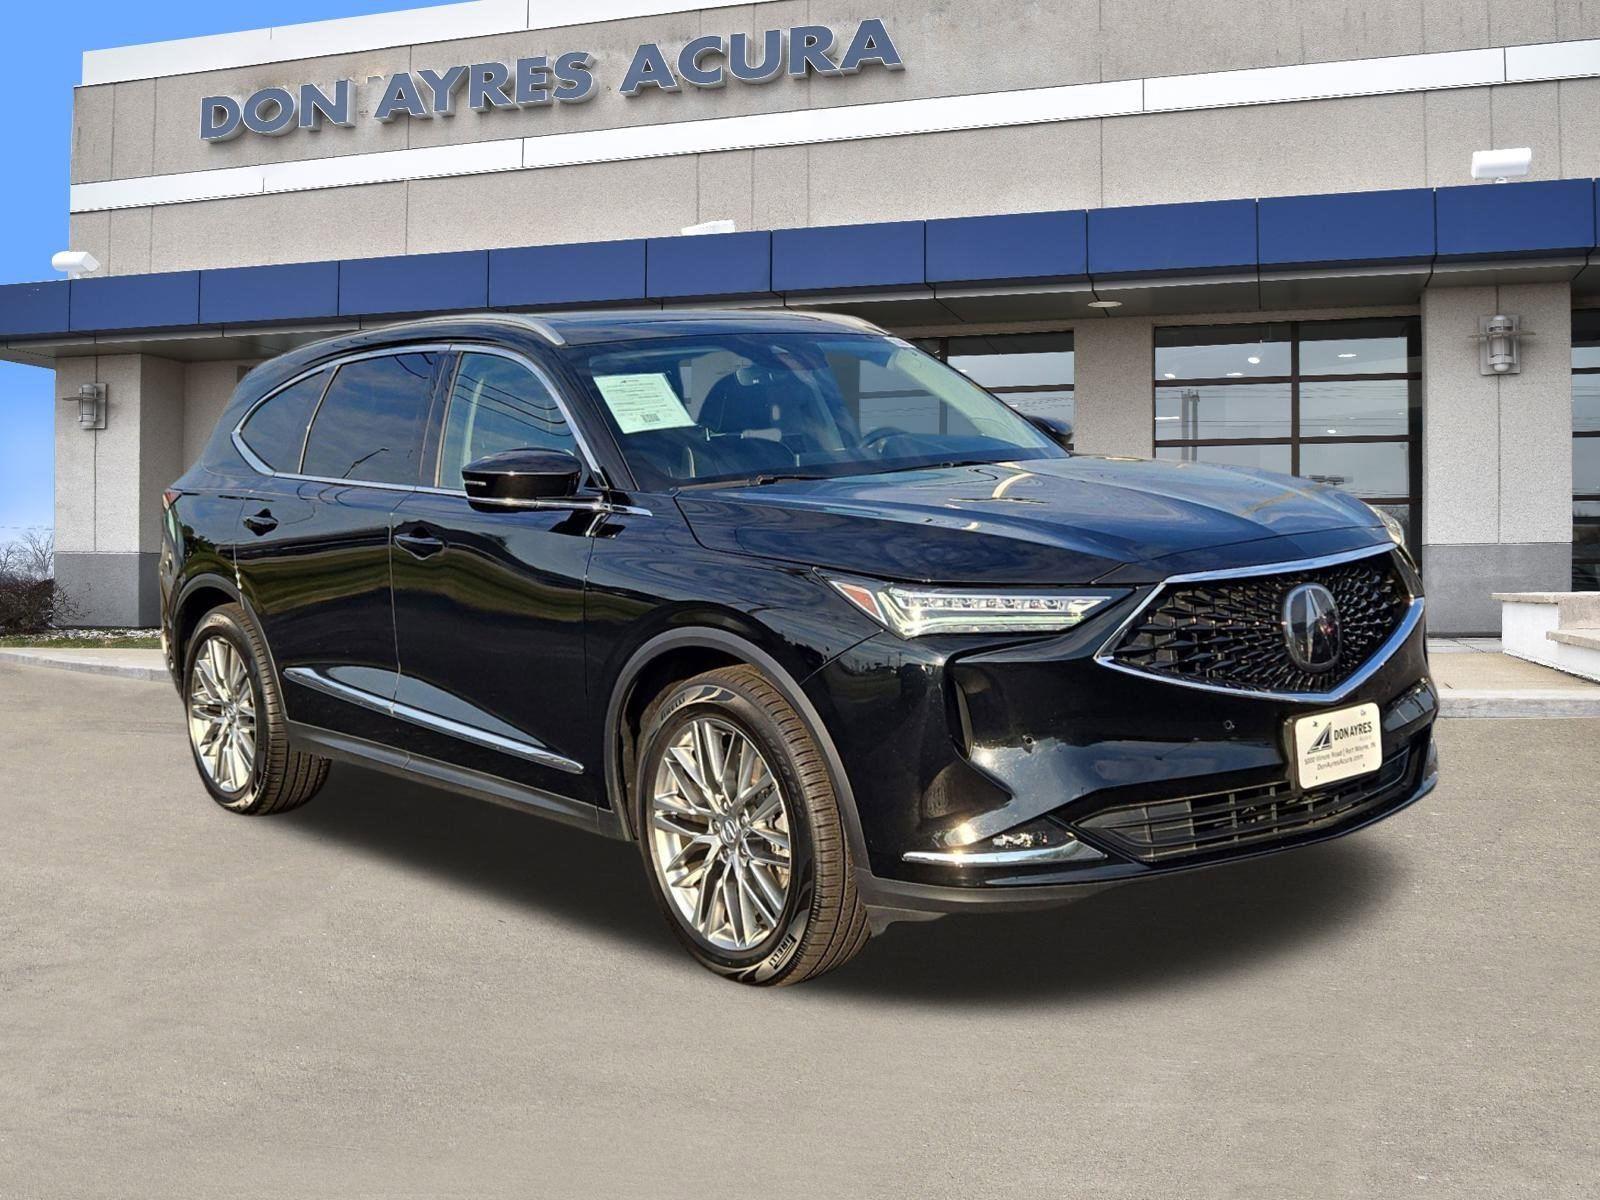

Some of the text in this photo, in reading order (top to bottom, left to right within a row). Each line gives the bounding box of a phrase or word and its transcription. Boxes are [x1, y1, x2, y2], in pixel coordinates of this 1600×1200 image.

[200, 17, 904, 142] DON AYRES ACURA
[768, 933, 797, 970] PIRELLI
